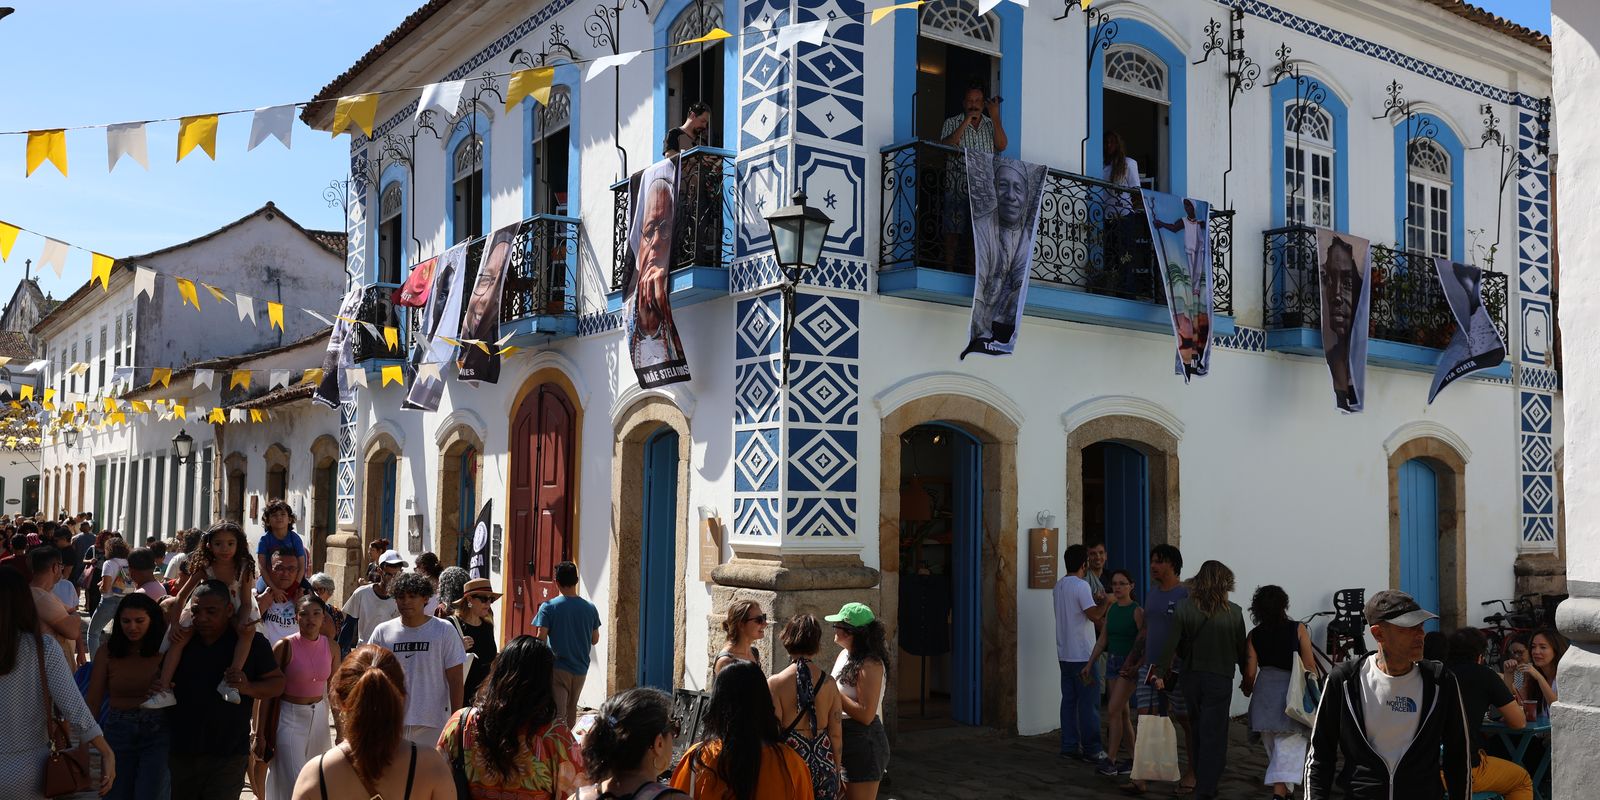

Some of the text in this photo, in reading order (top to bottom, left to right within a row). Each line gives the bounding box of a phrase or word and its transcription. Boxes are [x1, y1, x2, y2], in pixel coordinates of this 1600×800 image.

[1456, 360, 1477, 374] CIATA
[643, 369, 659, 383] MÃE
[659, 366, 677, 379] STELA
[394, 641, 428, 652] NIKE AIR
